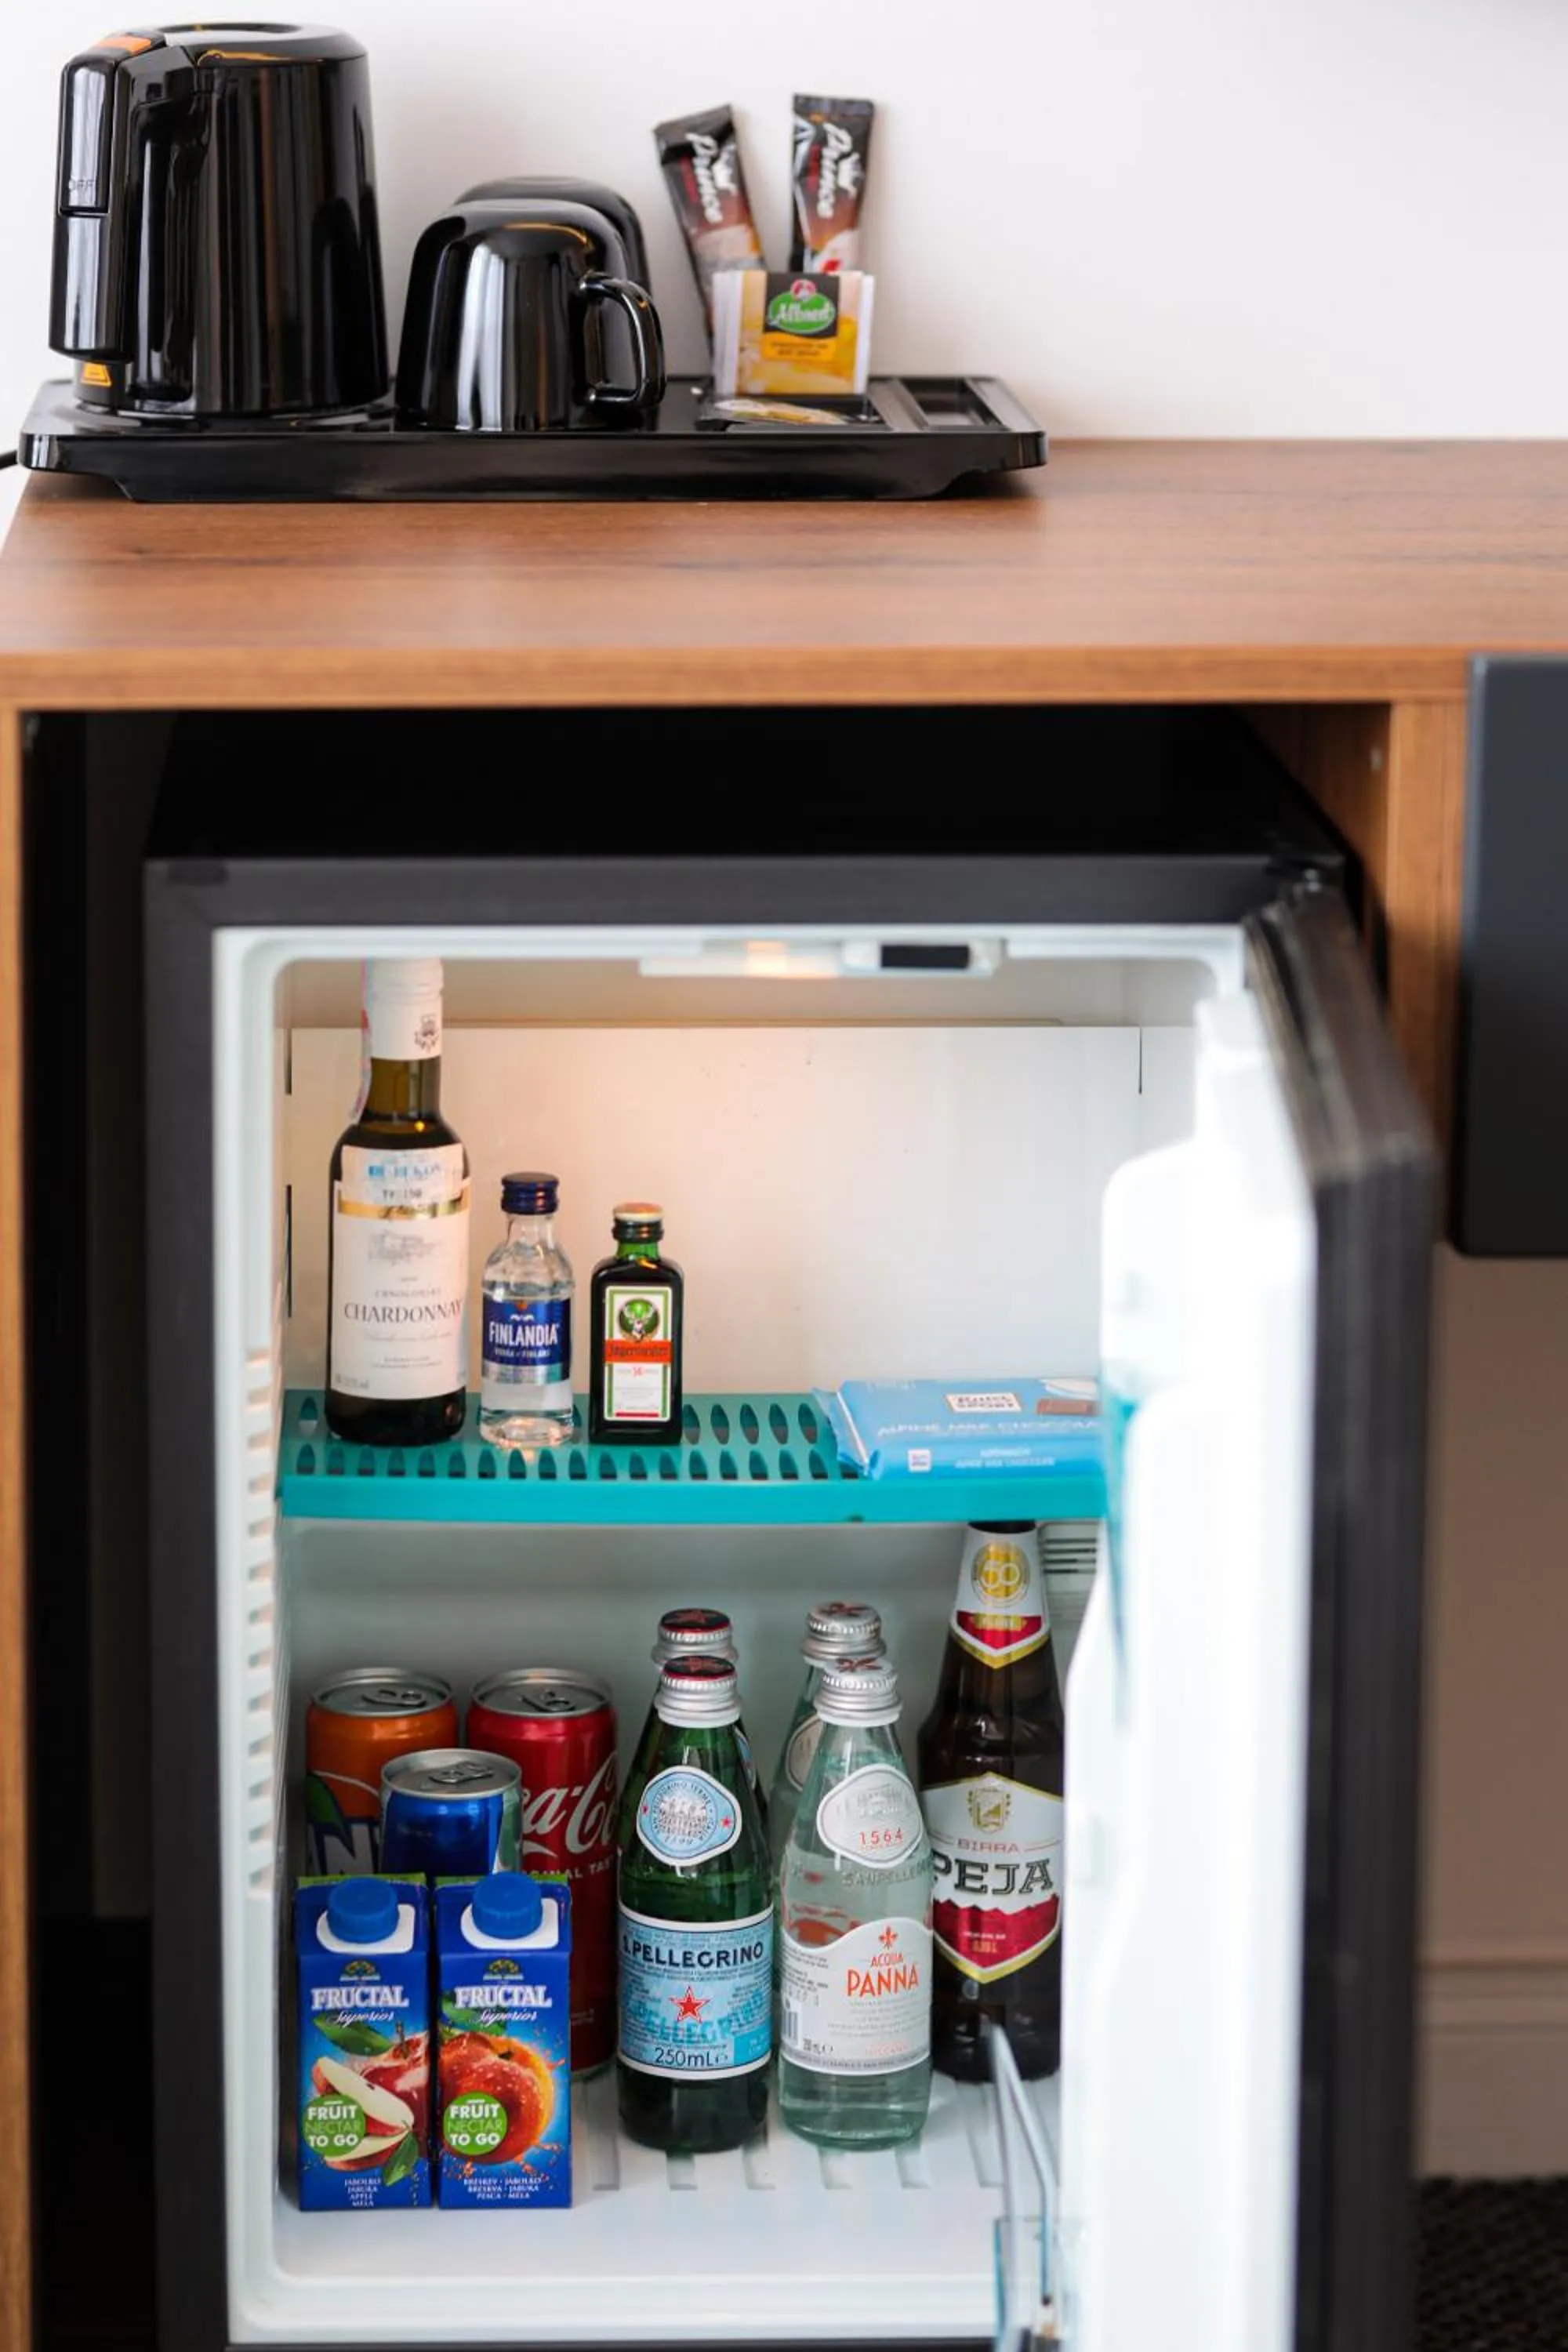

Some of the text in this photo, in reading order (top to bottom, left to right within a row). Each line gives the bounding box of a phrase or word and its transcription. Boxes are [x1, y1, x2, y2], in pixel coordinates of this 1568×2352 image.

[488, 1321, 558, 1346] FINLANDIA
[858, 1826, 903, 1846] 1564
[956, 1838, 1021, 1853] BIRRA
[847, 1962, 920, 1998] PANNA
[310, 1985, 410, 2011] FRUCTAL
[454, 1984, 553, 2009] FRUCTAL
[307, 2104, 358, 2121] FRUIT
[449, 2103, 501, 2120] FRUIT
[304, 2120, 360, 2134] NECTAR
[448, 2119, 503, 2133] NECTAR
[308, 2134, 358, 2147] TO GO
[449, 2132, 500, 2146] TO GO
